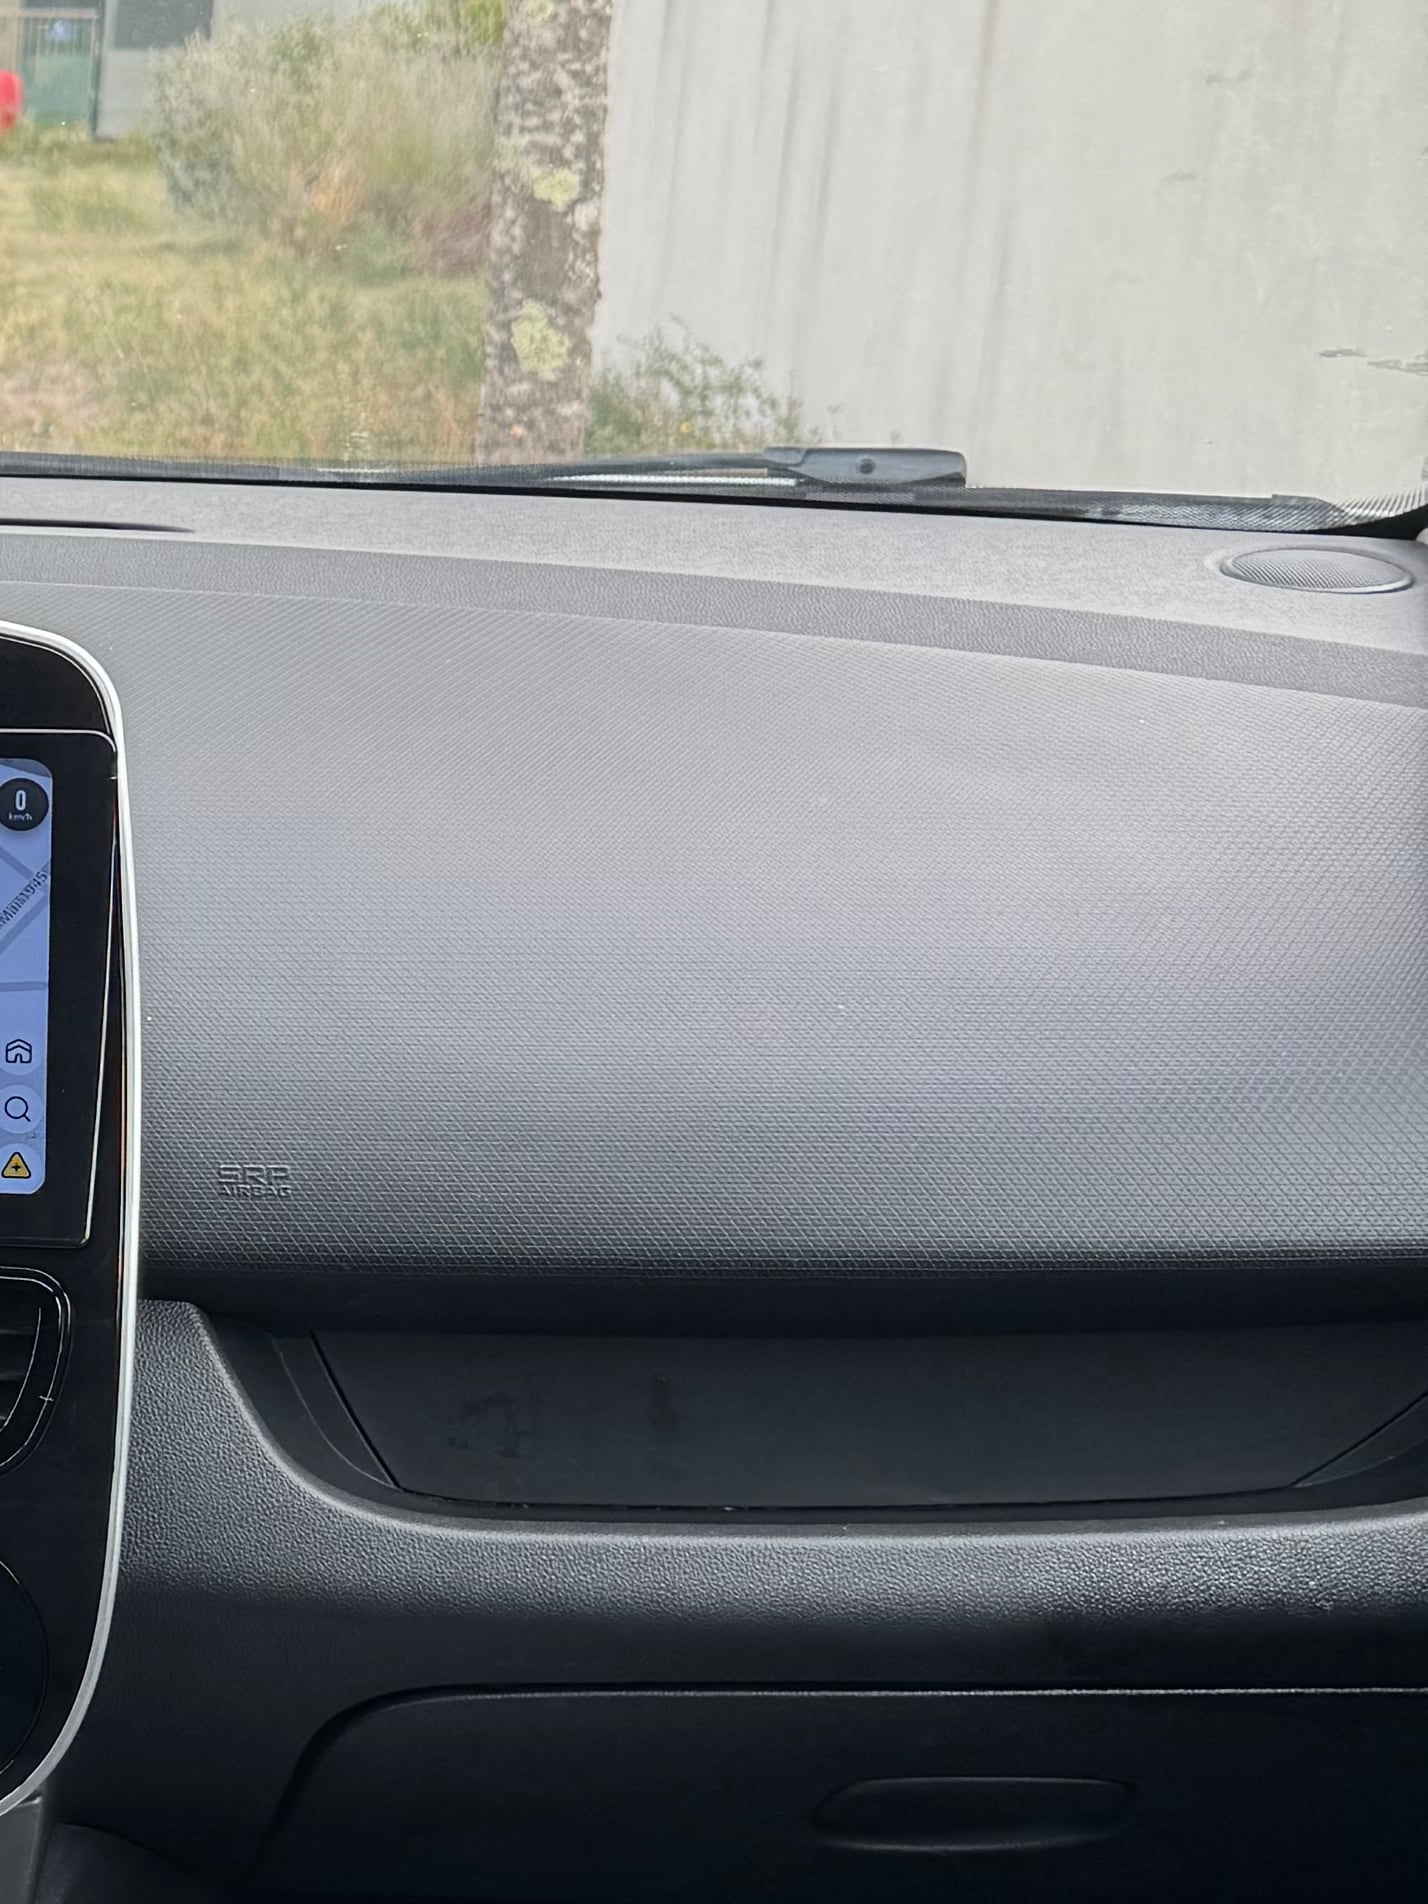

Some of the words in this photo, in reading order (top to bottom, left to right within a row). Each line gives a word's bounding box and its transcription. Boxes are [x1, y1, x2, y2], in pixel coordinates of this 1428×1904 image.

[16, 790, 26, 811] 0
[218, 1164, 291, 1185] SRP
[222, 1184, 292, 1197] AIRBAG
